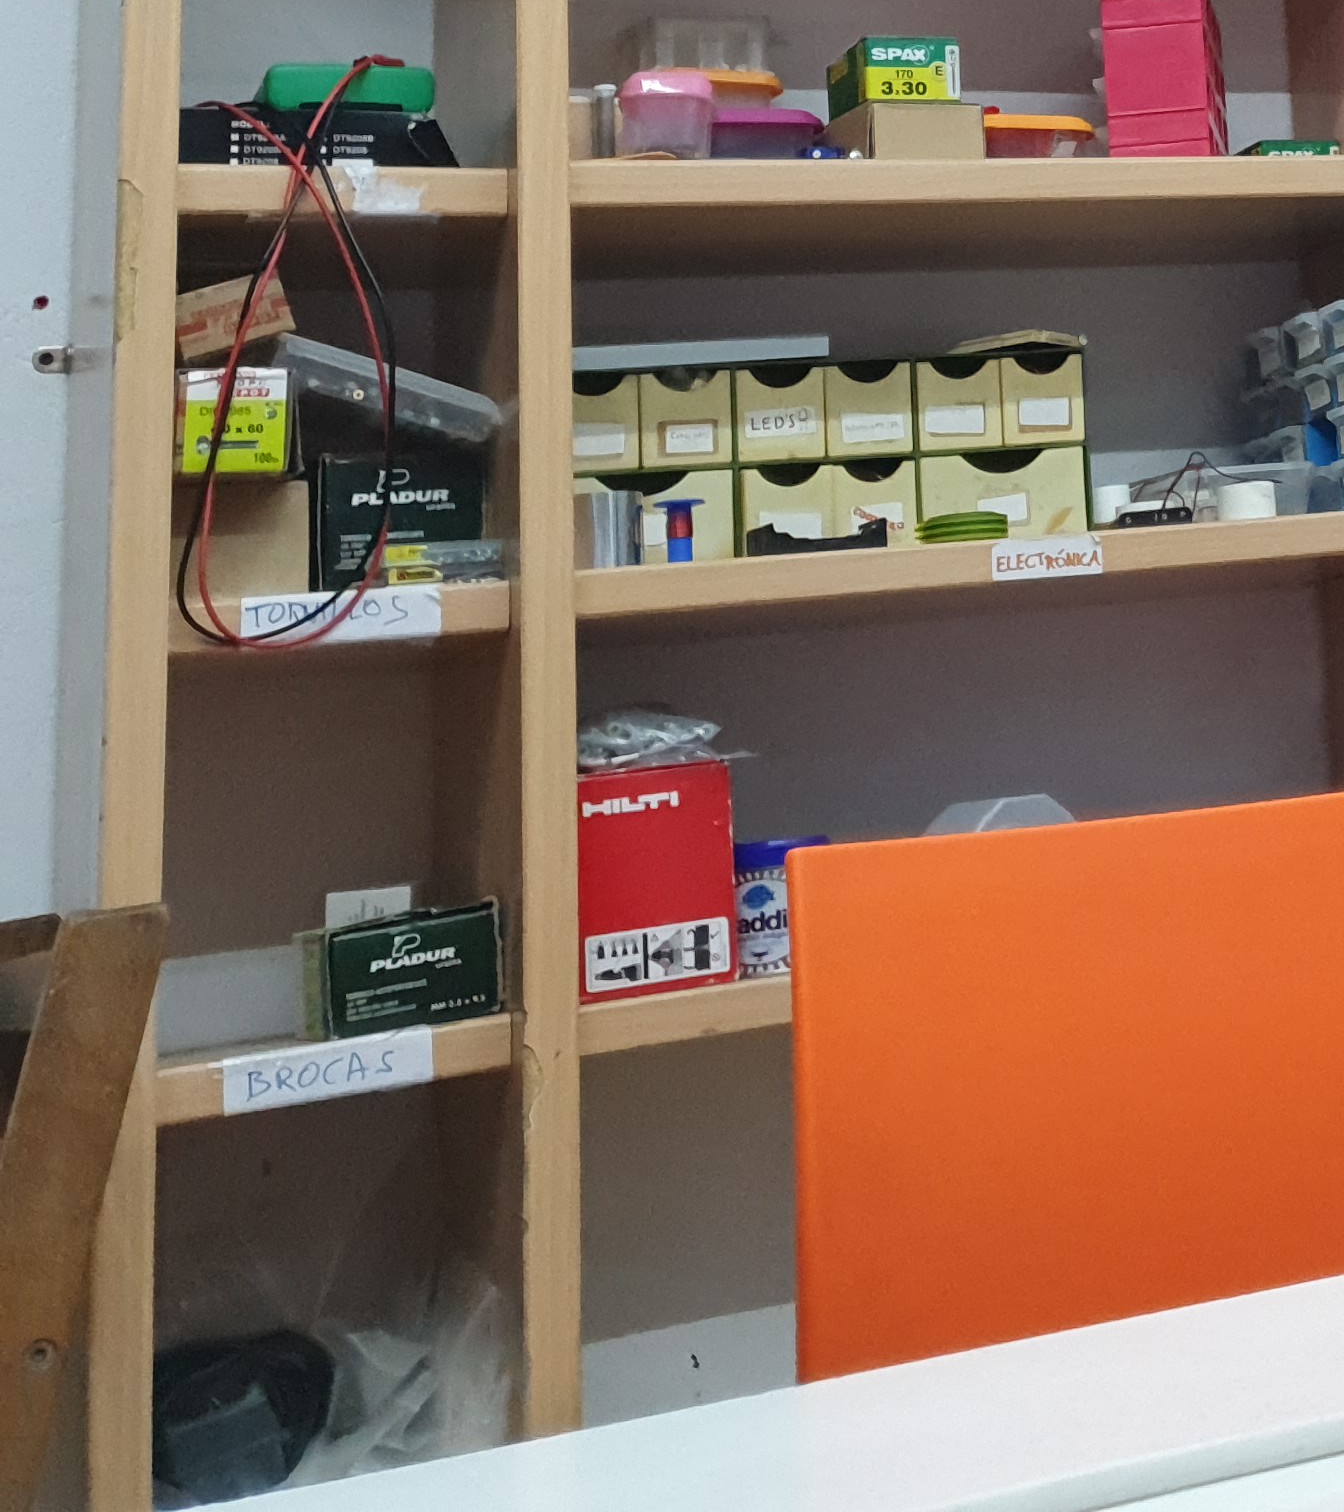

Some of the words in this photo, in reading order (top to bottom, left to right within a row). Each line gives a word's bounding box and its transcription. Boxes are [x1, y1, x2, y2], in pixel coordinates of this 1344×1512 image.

[871, 47, 926, 61] SPAX
[895, 69, 914, 79] 170
[995, 548, 1101, 573] ELECTRÓNICA
[582, 791, 680, 818] HILTI
[369, 946, 457, 973] PLADUR
[245, 1050, 396, 1102] BROCAS
